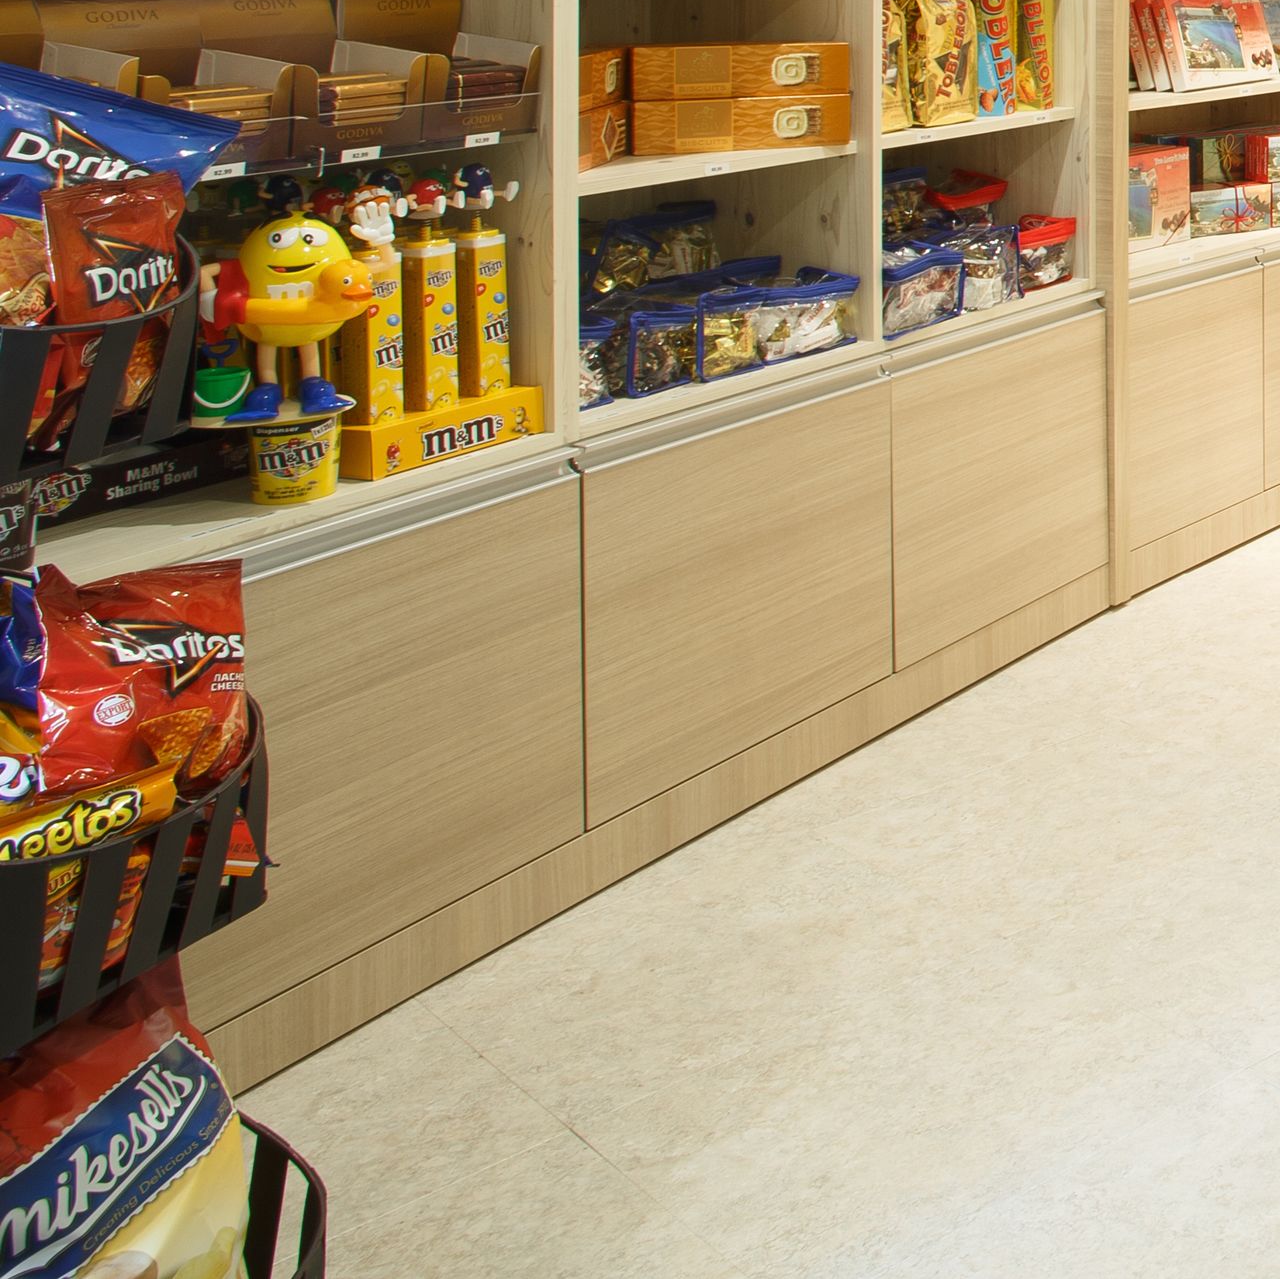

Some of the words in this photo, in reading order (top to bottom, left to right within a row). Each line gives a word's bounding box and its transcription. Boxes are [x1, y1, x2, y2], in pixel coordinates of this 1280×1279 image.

[85, 8, 159, 24] GODIVA
[420, 416, 504, 461] m&m's
[126, 459, 177, 482] M&M's
[106, 475, 156, 501] Sharing
[159, 465, 198, 489] Bowl
[97, 705, 134, 723] EXPORT
